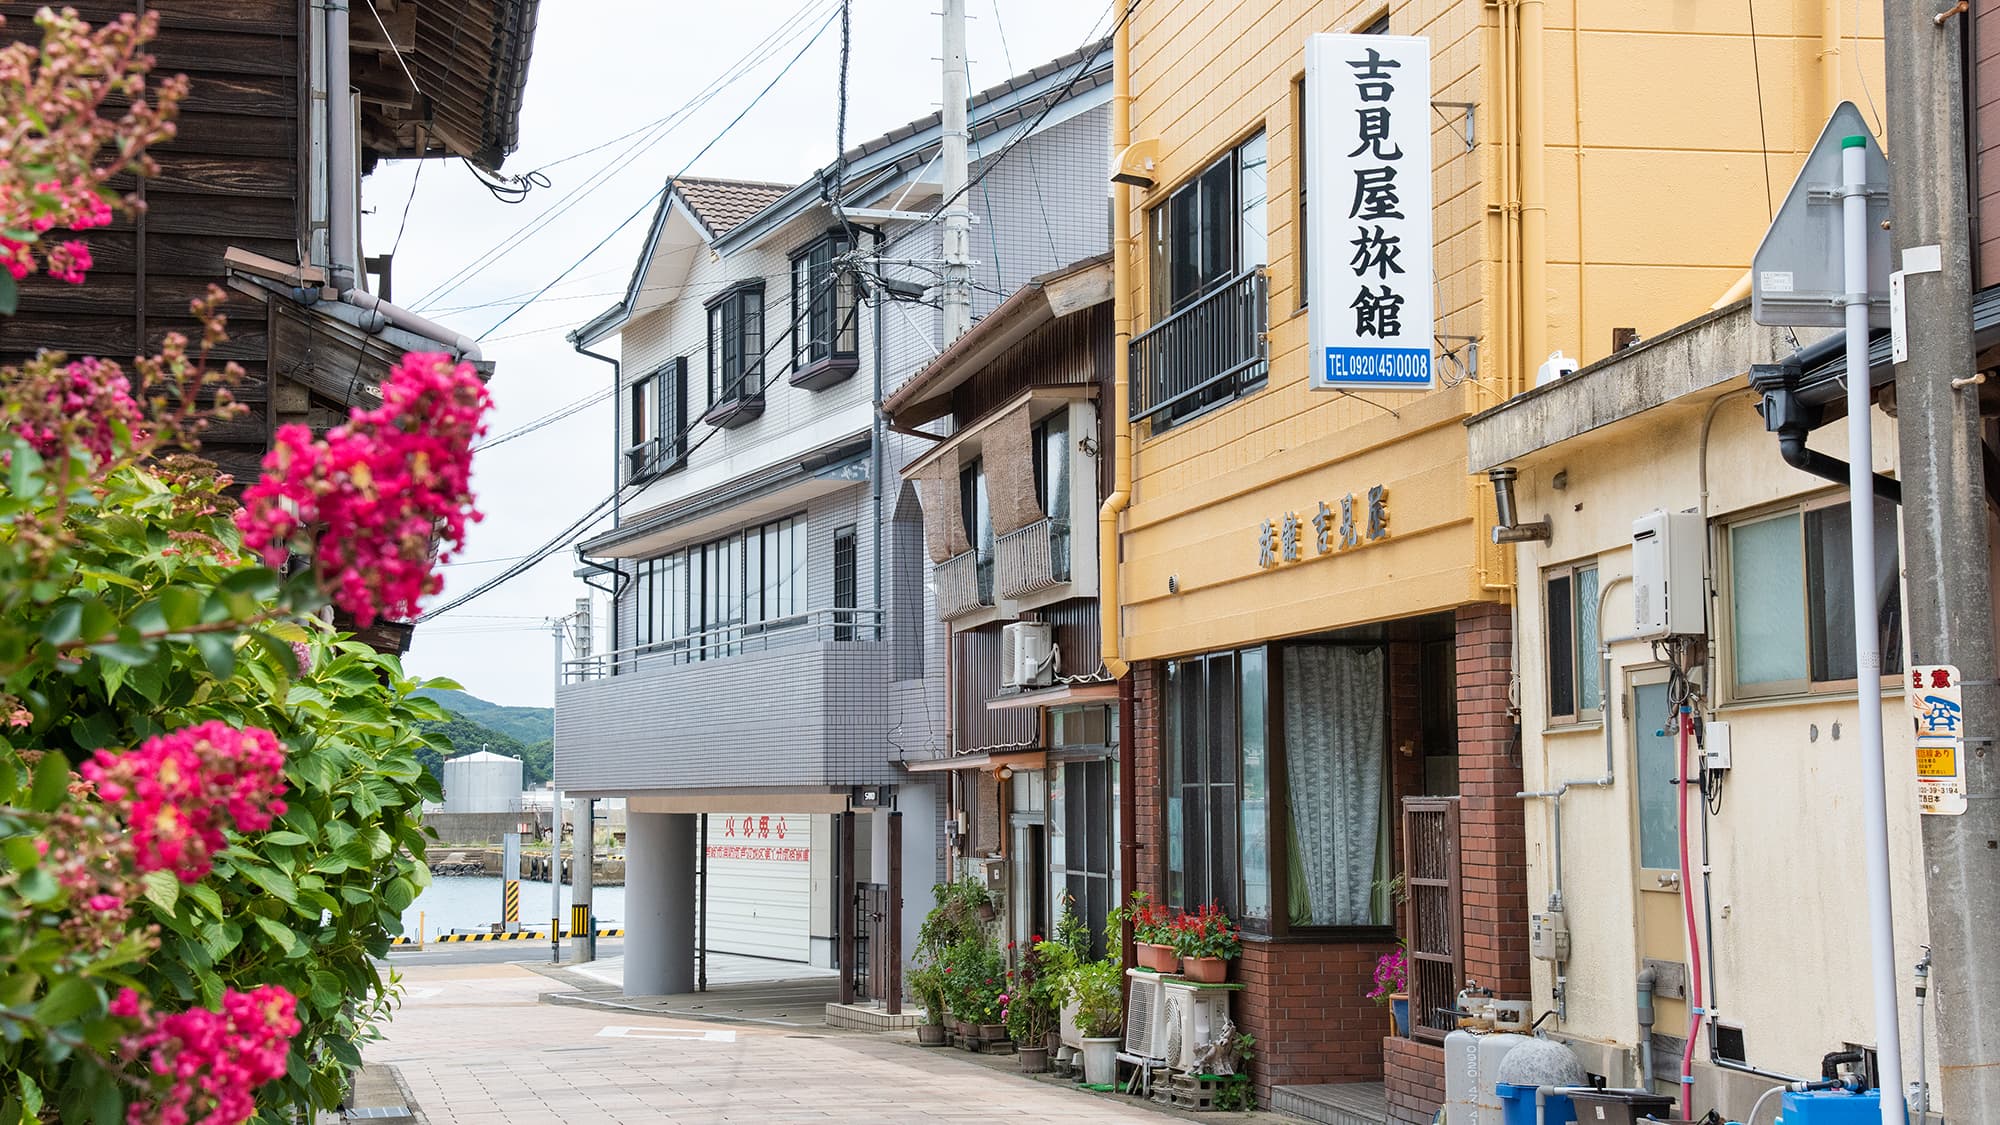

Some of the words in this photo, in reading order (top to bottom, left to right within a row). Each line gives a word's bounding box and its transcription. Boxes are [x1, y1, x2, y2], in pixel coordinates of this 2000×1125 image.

[1346, 48, 1405, 339] 吉見屋旅館
[1329, 354, 1348, 377] TEL
[1349, 353, 1428, 378] 0920(45)0008
[1311, 484, 1390, 555] 吉見屋
[725, 815, 788, 839] 火の用心
